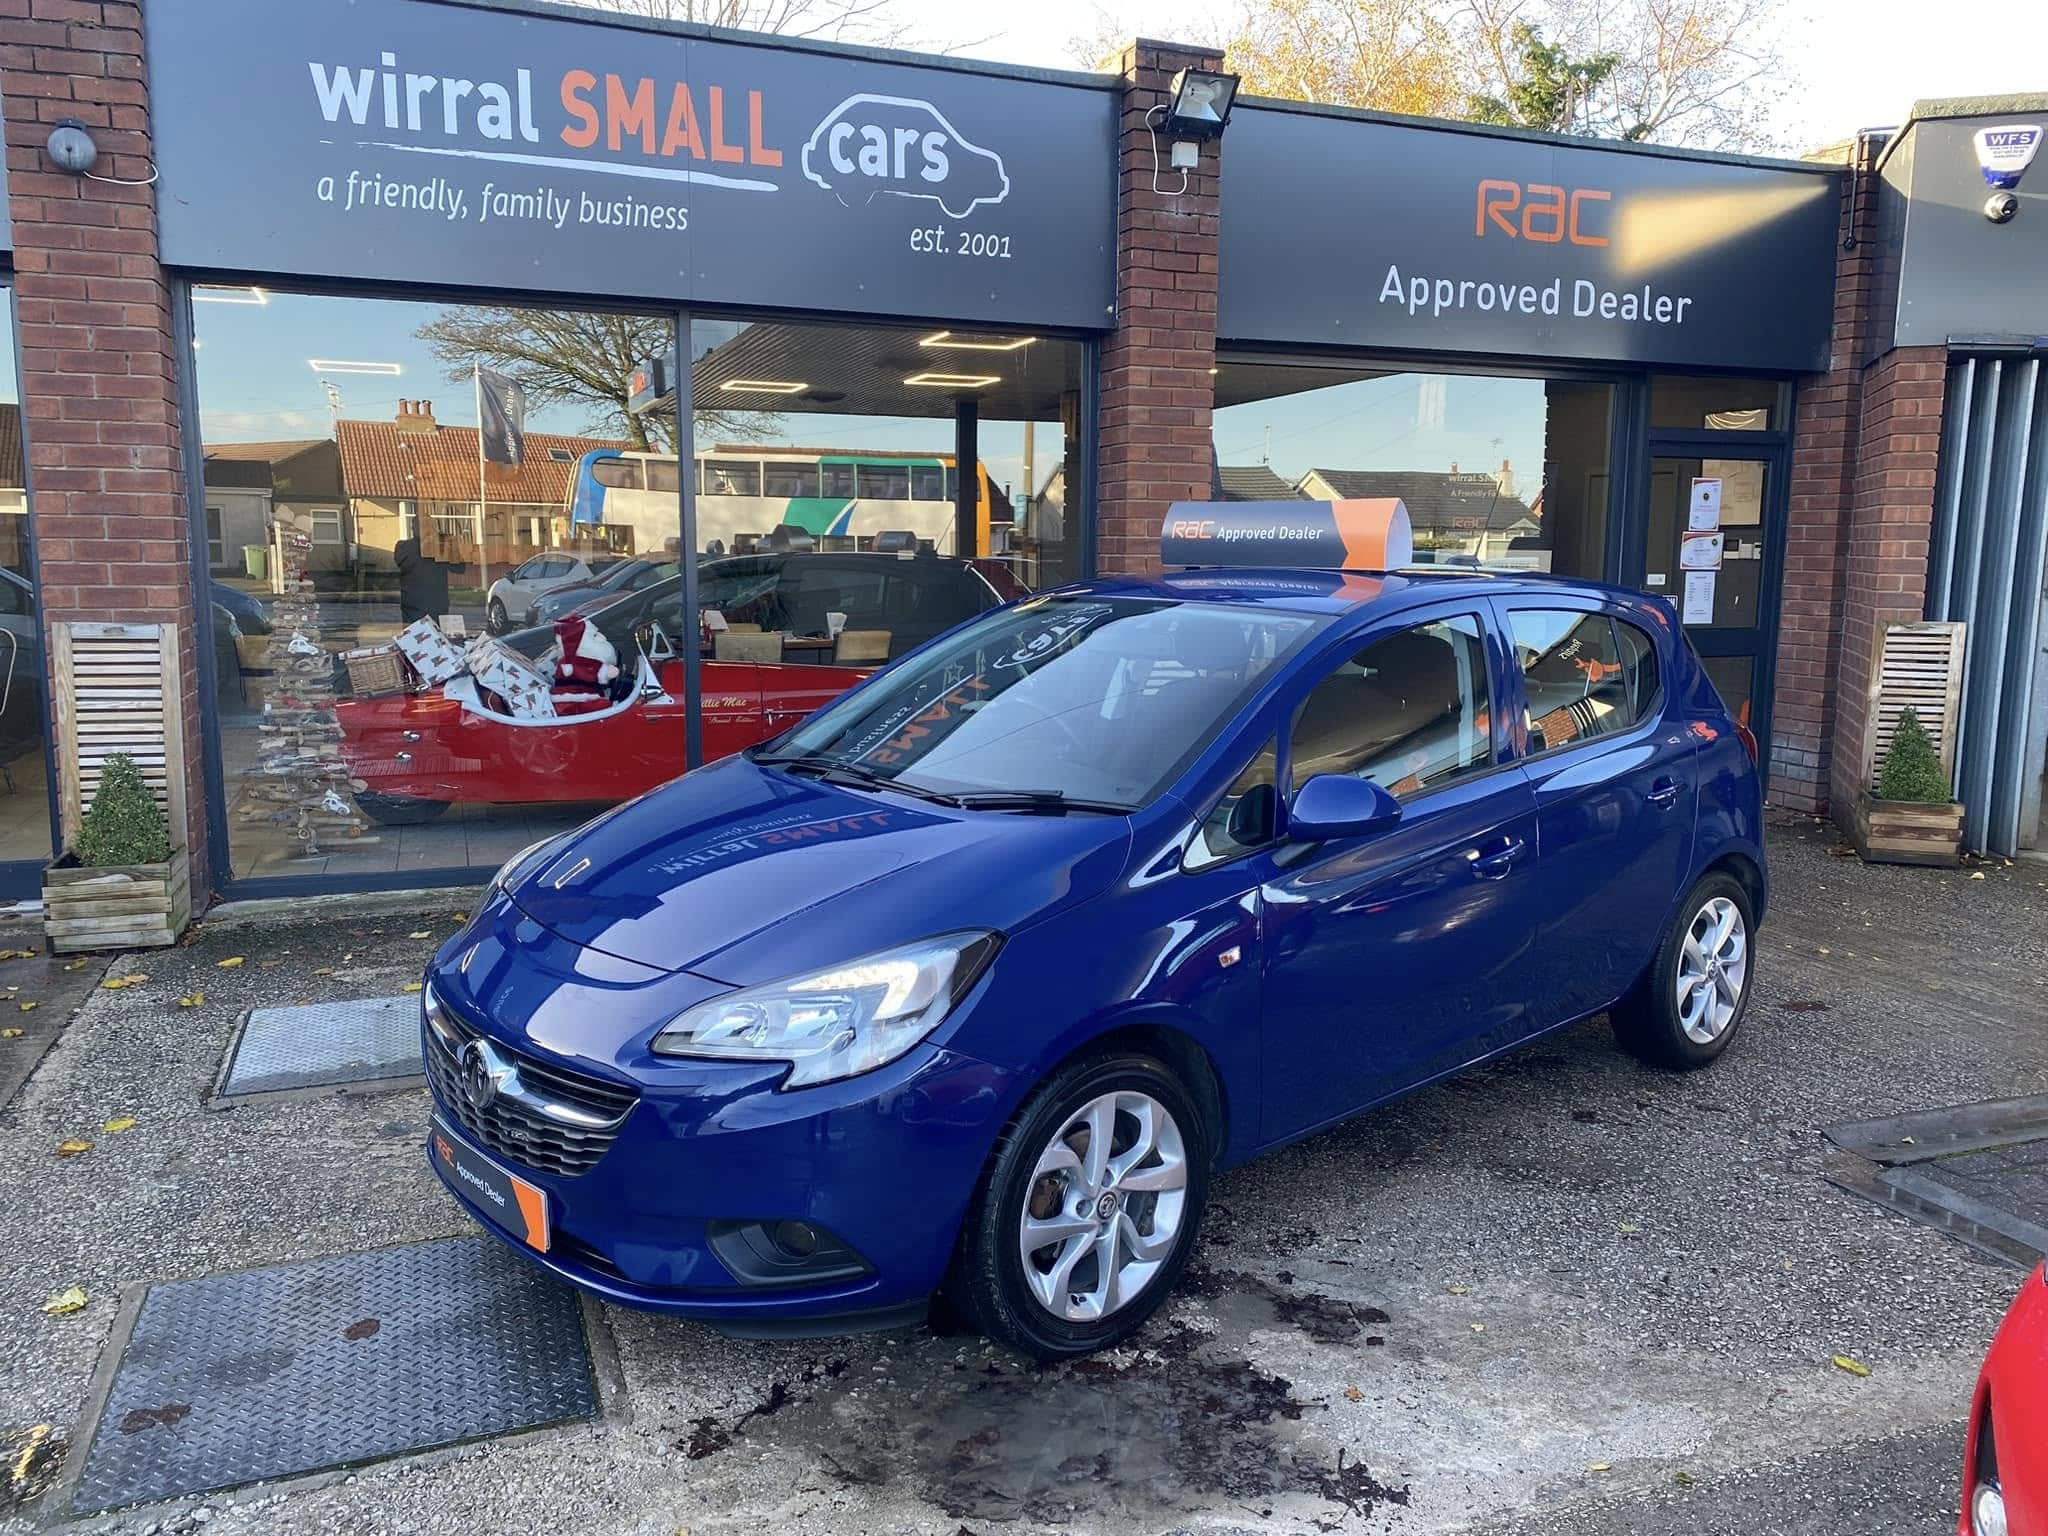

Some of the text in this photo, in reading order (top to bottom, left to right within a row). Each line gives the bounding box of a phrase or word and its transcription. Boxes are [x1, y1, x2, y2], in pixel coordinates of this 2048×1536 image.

[308, 51, 950, 183] wirral SMALL cars
[1990, 132, 2031, 145] WFS
[316, 170, 689, 231] a friendly, family business
[909, 224, 1012, 258] est. 2001
[1379, 264, 1694, 324] Approved Dealer
[1217, 525, 1275, 543] Approved
[1279, 526, 1324, 541] Dealer
[456, 1160, 484, 1192] Approved
[484, 1181, 505, 1208] Dealer
